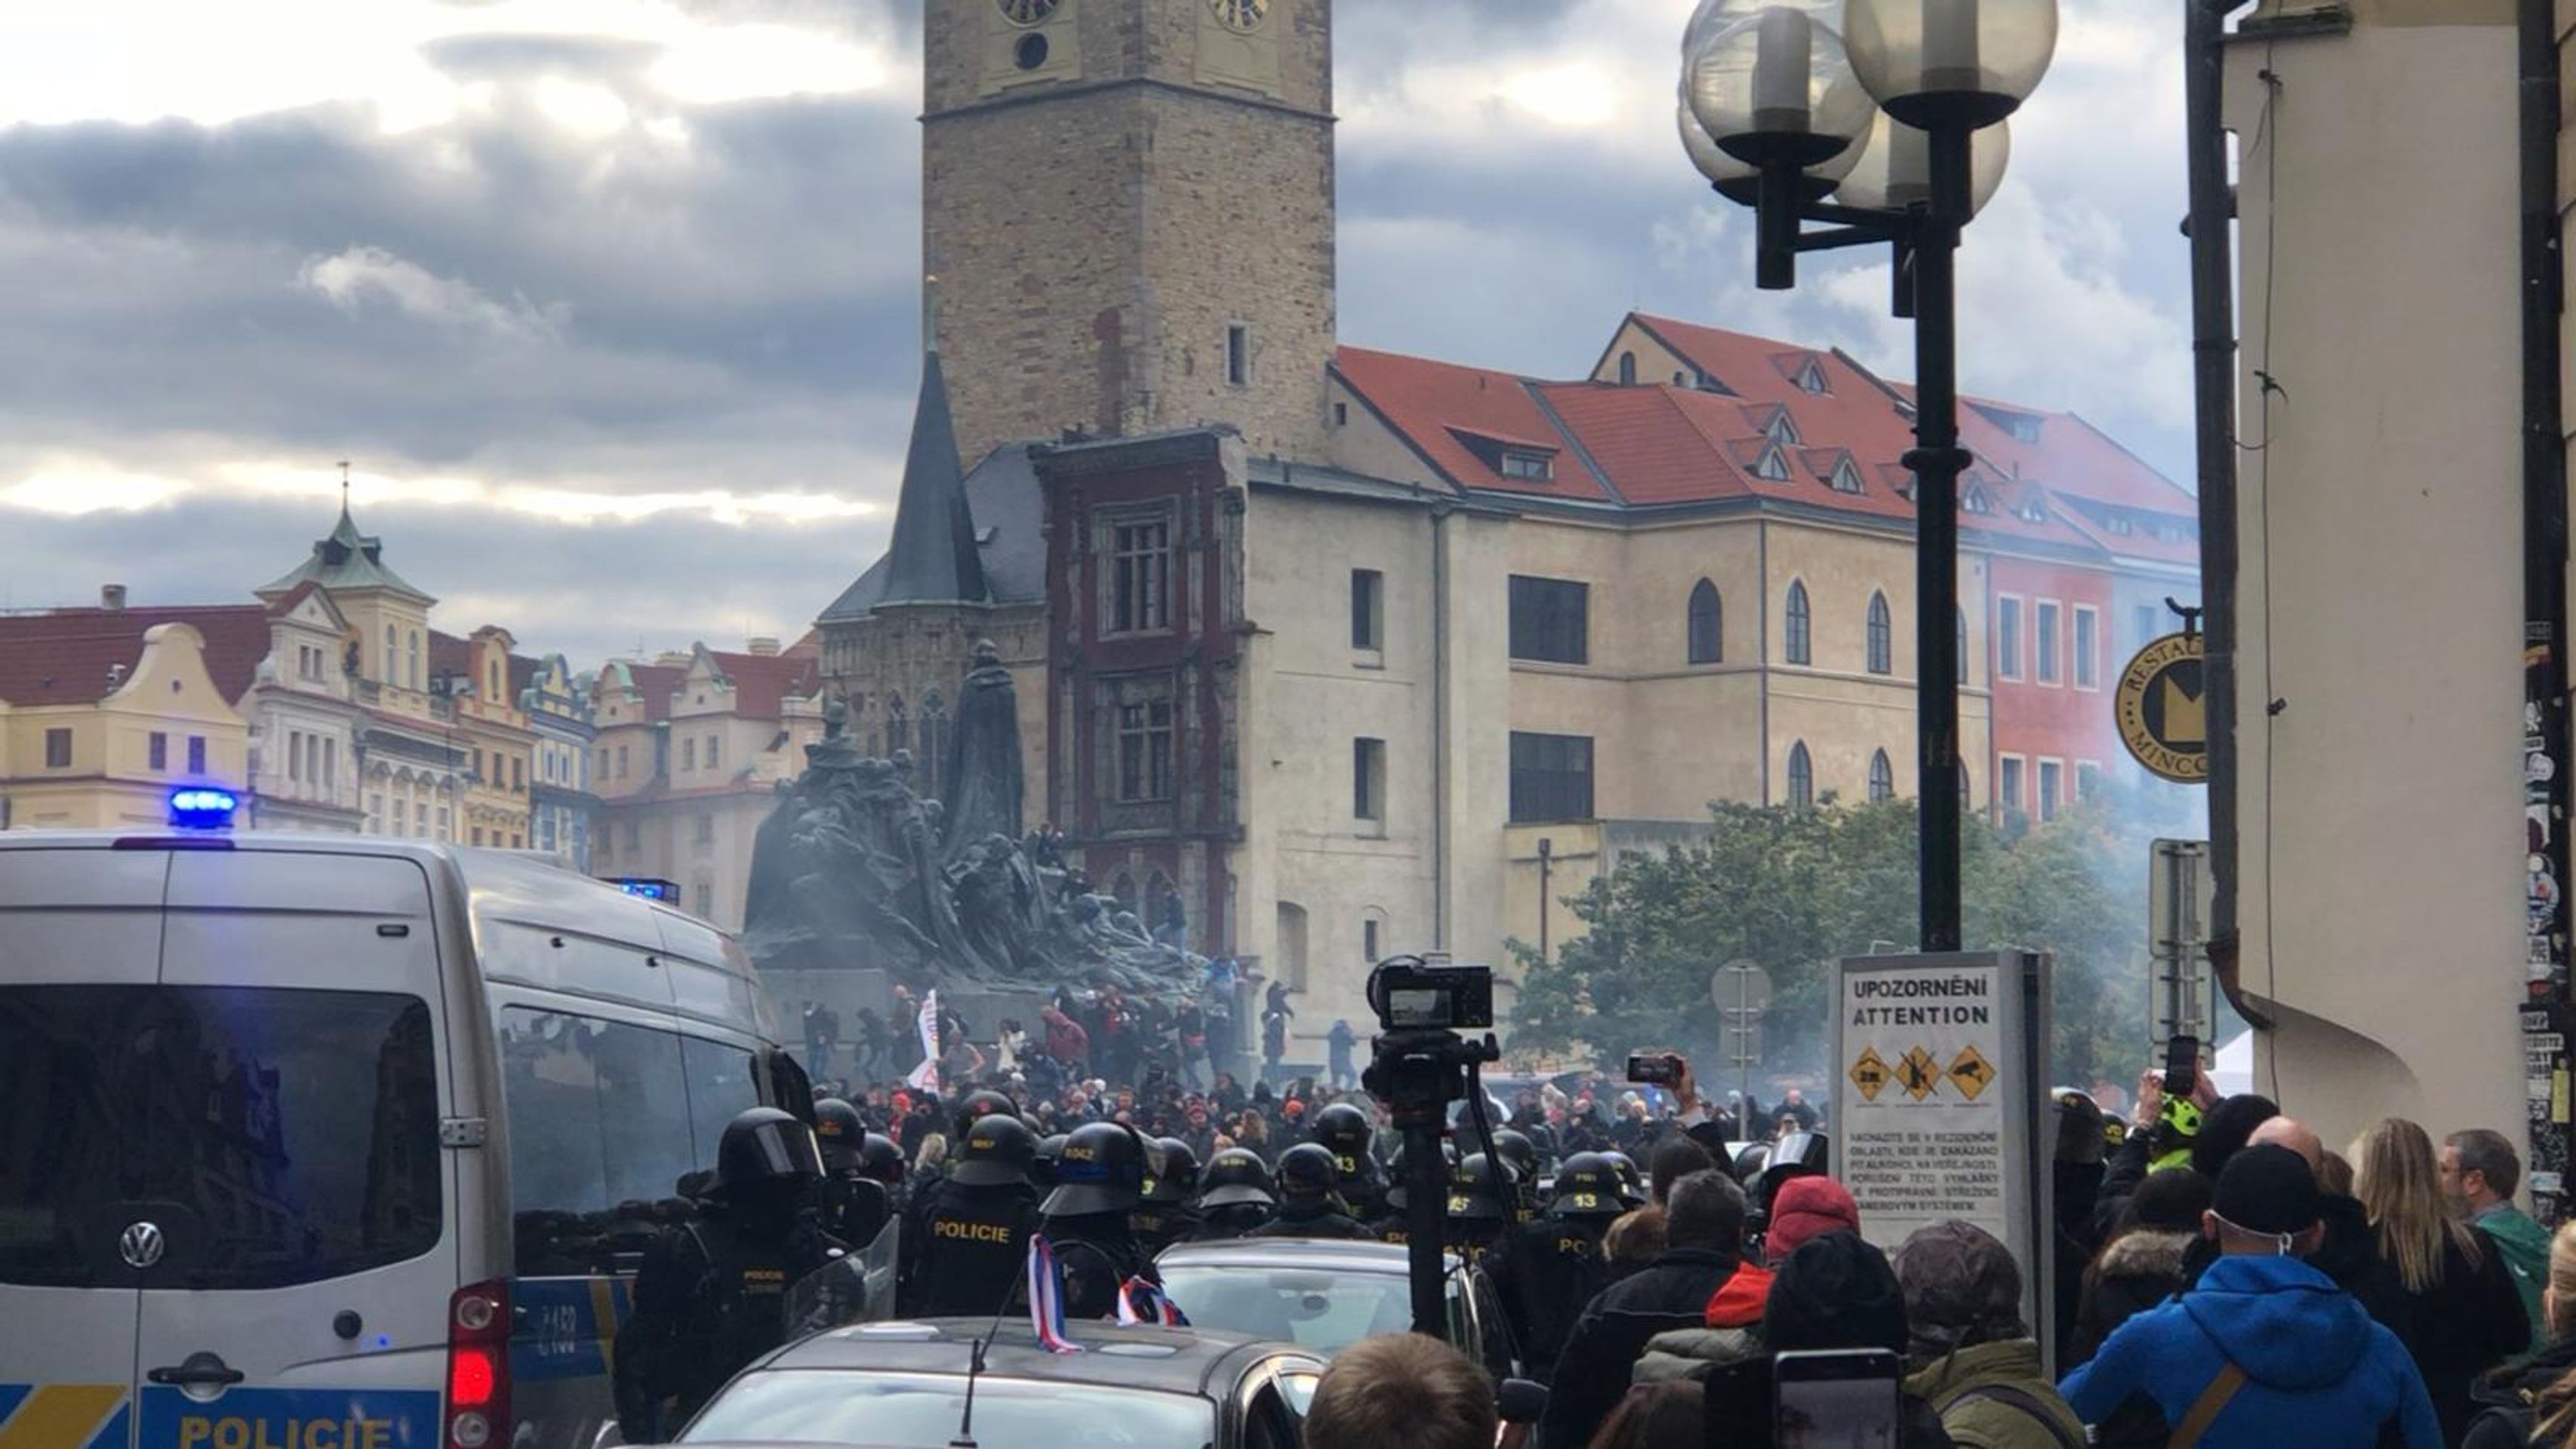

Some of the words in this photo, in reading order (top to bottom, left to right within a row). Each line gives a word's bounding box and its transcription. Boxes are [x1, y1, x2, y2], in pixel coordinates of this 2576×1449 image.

[1854, 974, 1987, 998] UPOZORNĚNÍ
[1854, 1006, 1989, 1026] ATTENTION
[1574, 1194, 1597, 1208] 13
[934, 1221, 1011, 1244] POLICIE
[180, 1416, 393, 1449] POLICIE
